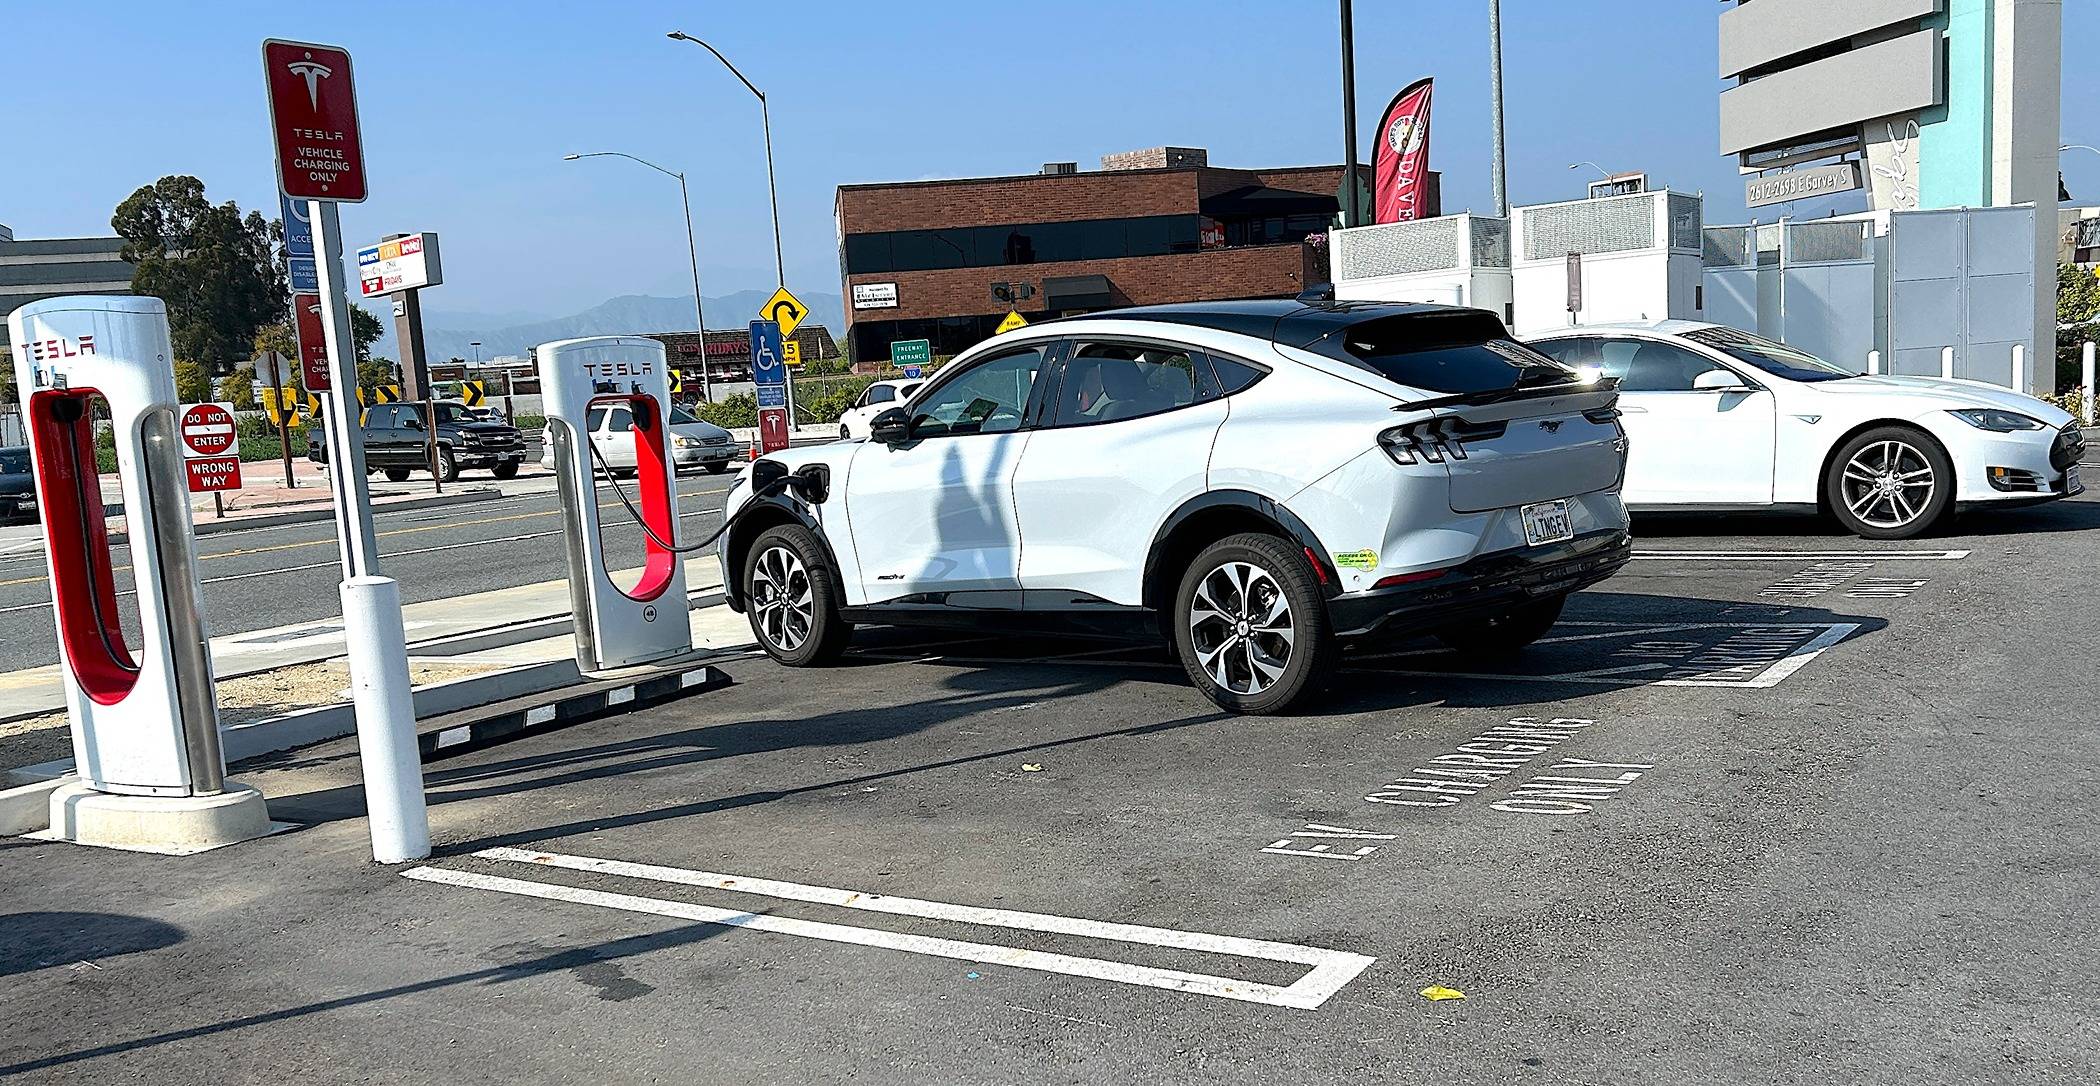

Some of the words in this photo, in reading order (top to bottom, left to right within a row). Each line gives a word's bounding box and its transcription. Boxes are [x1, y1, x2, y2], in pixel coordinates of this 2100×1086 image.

[293, 128, 343, 140] TESLA
[298, 146, 343, 159] VEHICLE
[294, 158, 350, 171] CHARGING
[309, 171, 338, 183] ONLY
[1750, 178, 1797, 201] 2612-2698
[1798, 176, 1805, 193] E
[1805, 174, 1838, 191] Garvey
[1840, 167, 1847, 185] S
[21, 336, 95, 362] TESLA
[896, 353, 926, 361] ENTRANCE
[583, 362, 652, 377] TESLA
[187, 414, 201, 423] DO
[207, 412, 227, 423] NOT
[194, 436, 226, 446] ENTER
[191, 462, 234, 474] WRONG
[201, 475, 227, 487] WAY
[1532, 514, 1568, 538] LTNGEV
[1842, 577, 1931, 598] ONLY
[1610, 641, 1703, 658] NO
[1662, 628, 1814, 680] PARKING
[1259, 823, 1398, 861] EV
[1364, 716, 1598, 808] CHARGING
[1490, 757, 1654, 815] ONLY
